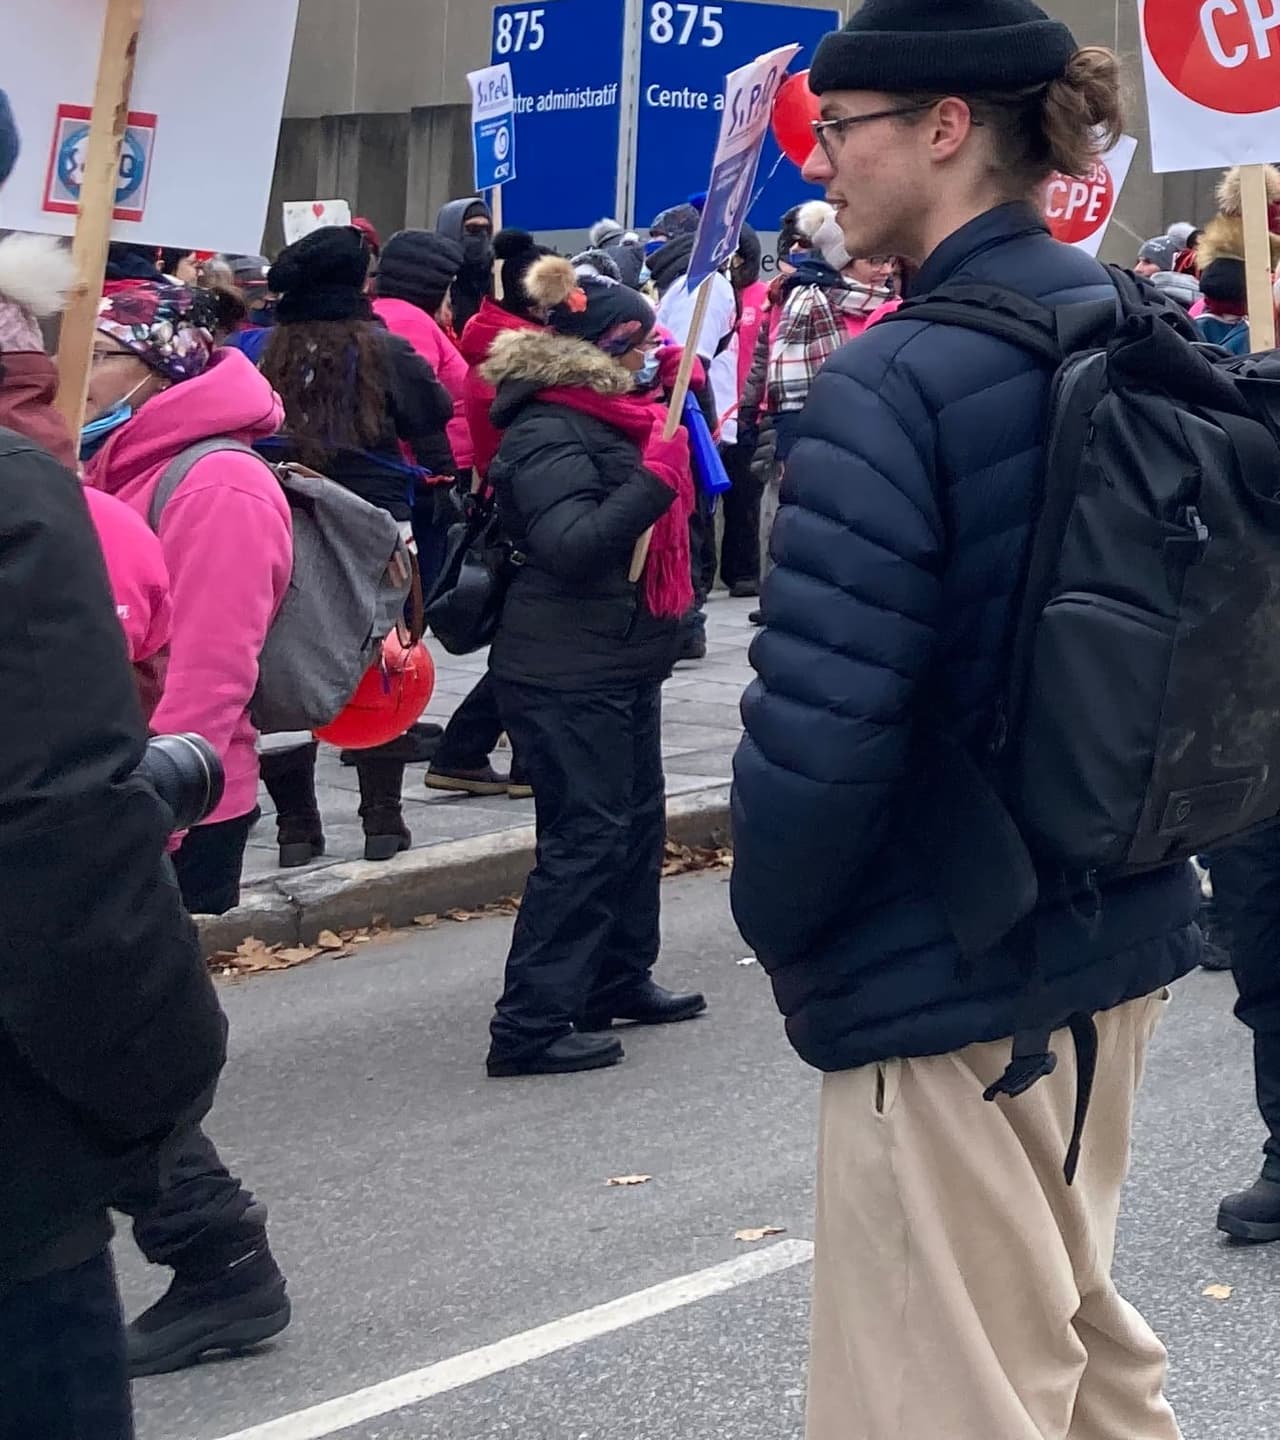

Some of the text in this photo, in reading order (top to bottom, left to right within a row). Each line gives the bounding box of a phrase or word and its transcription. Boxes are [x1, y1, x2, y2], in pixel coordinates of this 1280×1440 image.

[496, 9, 545, 54] 875
[650, 1, 724, 47] 875
[536, 83, 618, 112] administratif
[647, 84, 708, 110] Centre
[1045, 180, 1106, 222] CPE
